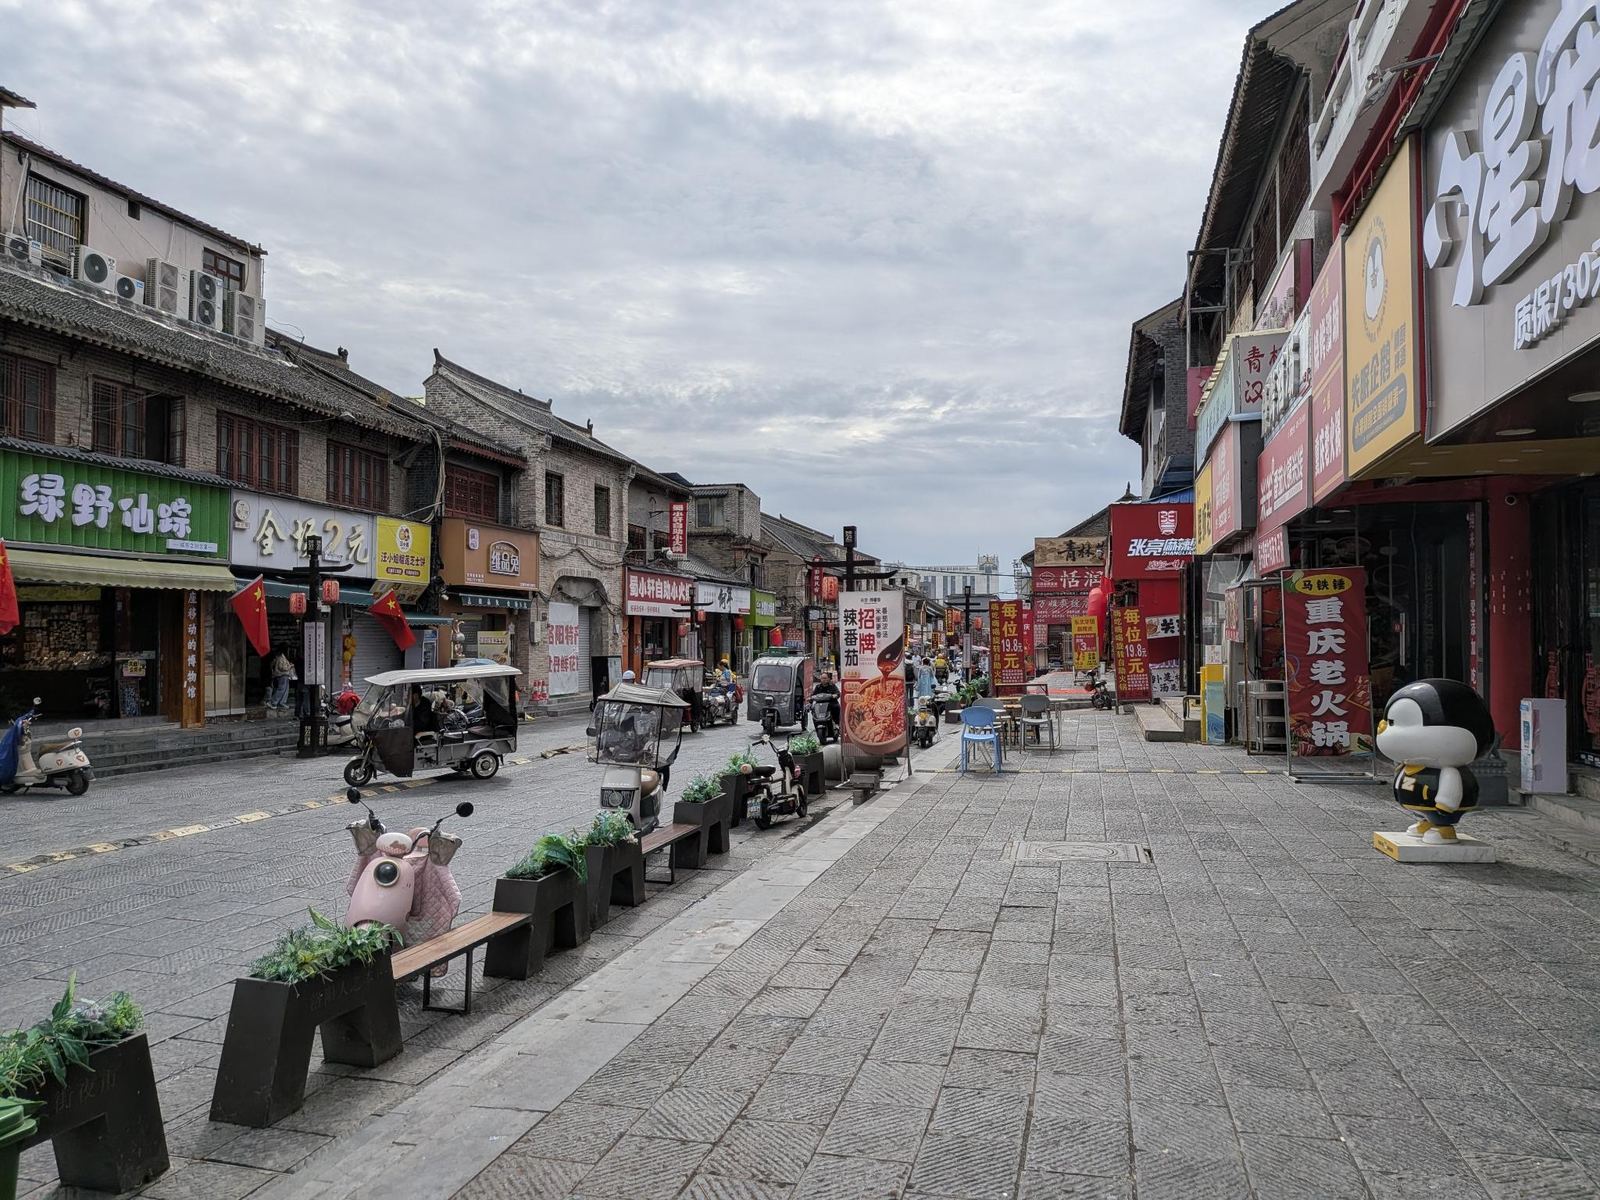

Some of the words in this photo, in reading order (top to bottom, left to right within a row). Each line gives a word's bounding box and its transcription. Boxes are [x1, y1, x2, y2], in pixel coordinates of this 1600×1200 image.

[20, 473, 192, 538] 绿野仙踪
[1302, 578, 1345, 591] 马铁锤
[843, 608, 858, 667] 辣番茄
[858, 608, 876, 654] 招牌
[1002, 603, 1018, 637] 每位
[1124, 609, 1142, 643] 每位
[549, 656, 579, 673] 丹鲜花
[1305, 597, 1350, 748] 重庆老火锅
